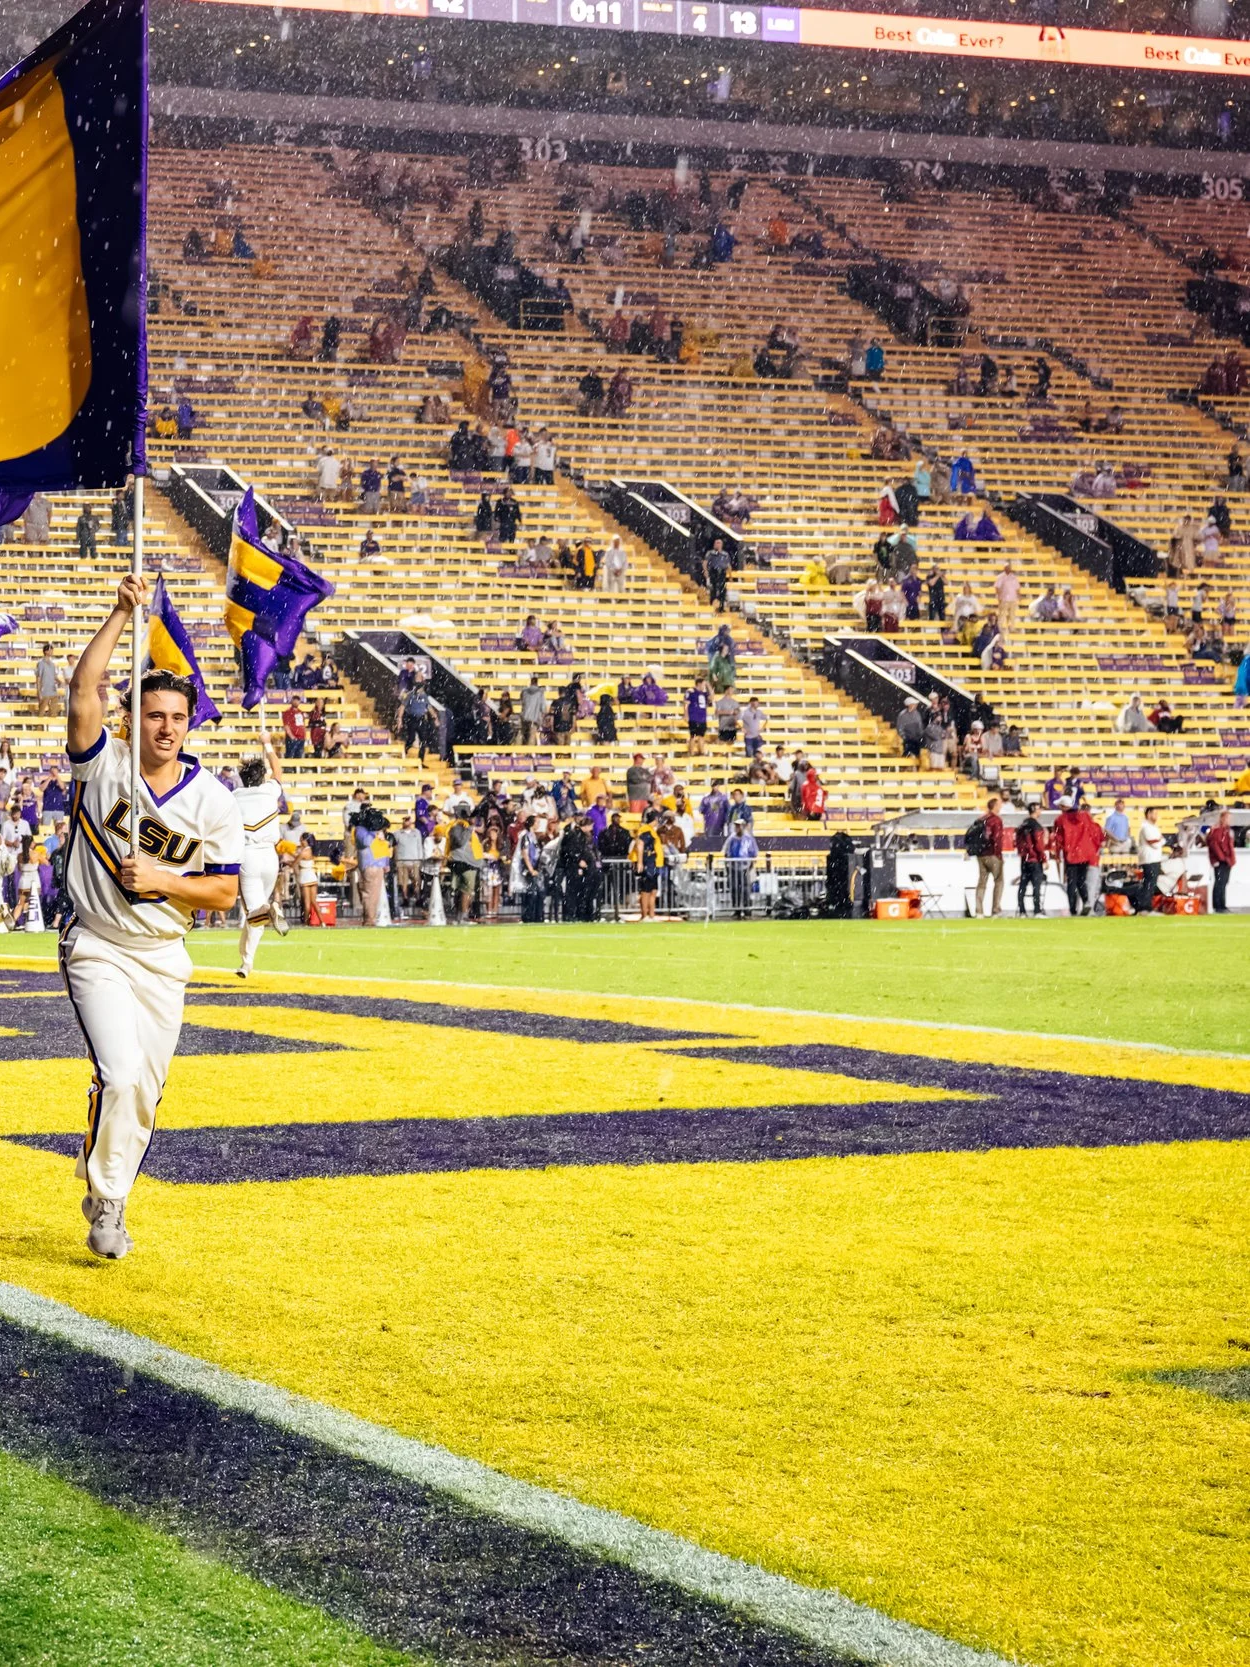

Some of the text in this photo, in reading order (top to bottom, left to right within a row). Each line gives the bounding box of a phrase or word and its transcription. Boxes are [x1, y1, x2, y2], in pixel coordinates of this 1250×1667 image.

[569, 1, 622, 25] 0:11
[730, 11, 757, 34] 13
[874, 26, 913, 42] Best
[959, 33, 1004, 48] Ever?
[1144, 46, 1181, 61] Best
[102, 797, 203, 867] LSU
